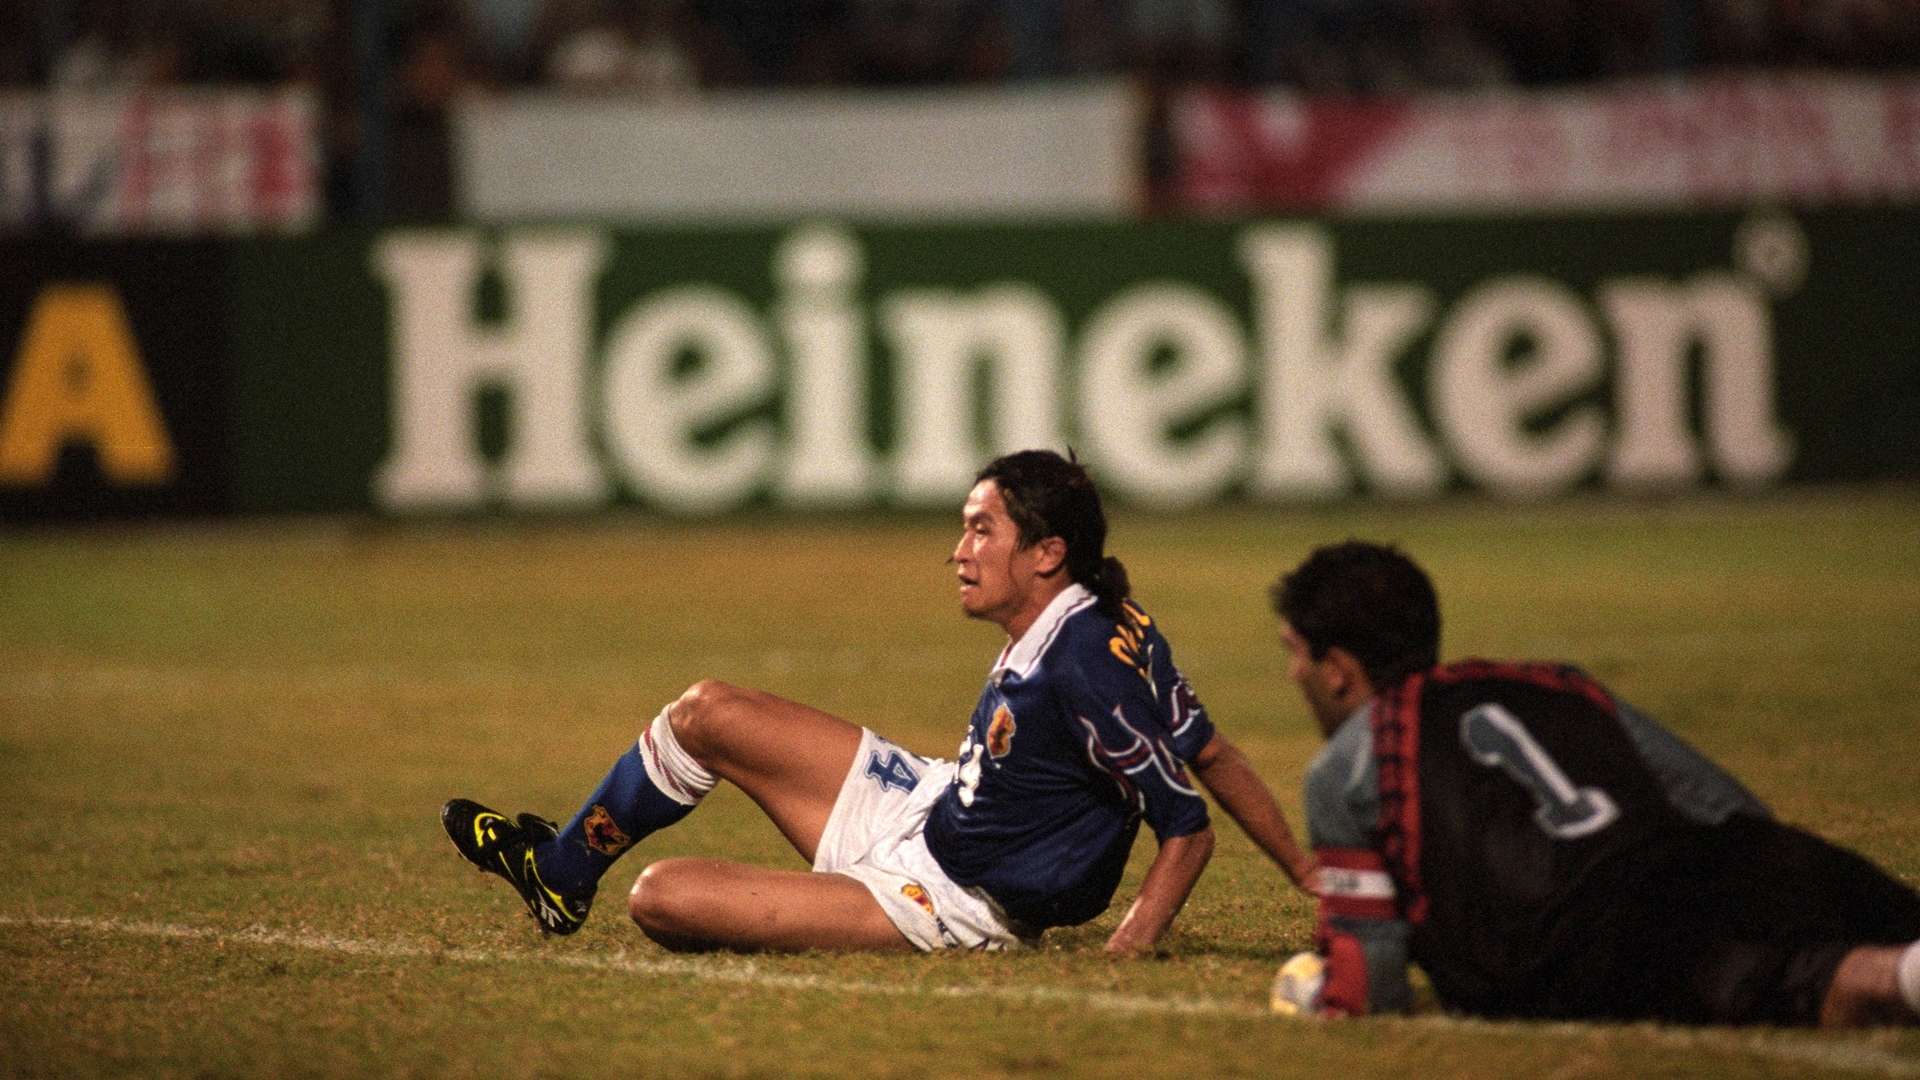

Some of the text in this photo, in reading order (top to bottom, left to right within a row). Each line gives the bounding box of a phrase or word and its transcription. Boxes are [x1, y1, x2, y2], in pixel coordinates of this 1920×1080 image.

[0, 284, 174, 486] A
[374, 224, 1793, 512] Heineken
[1459, 703, 1620, 840] 1
